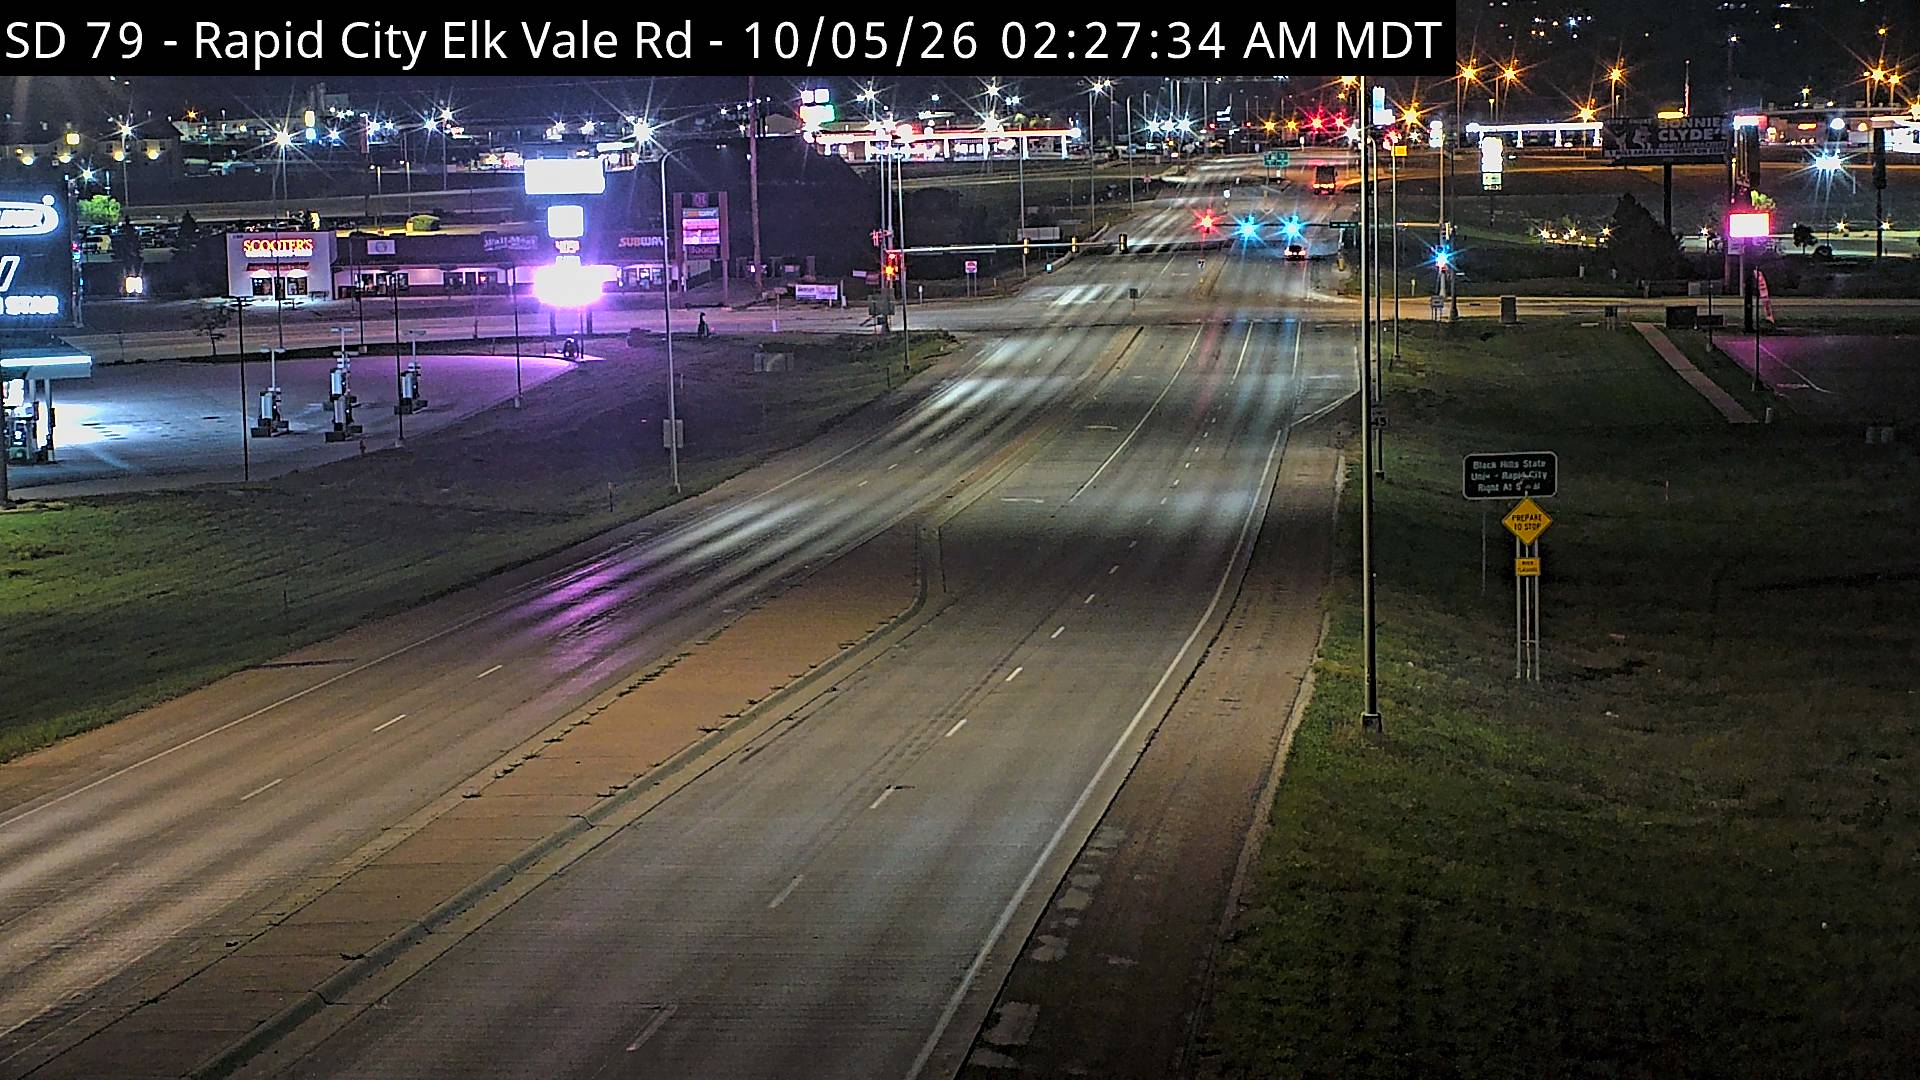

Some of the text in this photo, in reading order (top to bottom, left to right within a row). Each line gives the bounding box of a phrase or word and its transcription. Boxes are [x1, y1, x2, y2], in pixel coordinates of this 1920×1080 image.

[1472, 459, 1547, 470] Black Hills State
[1528, 470, 1548, 480] City
[1477, 482, 1500, 494] Right
[1511, 513, 1543, 522] PREPARE
[1513, 522, 1542, 531] TO STOP
